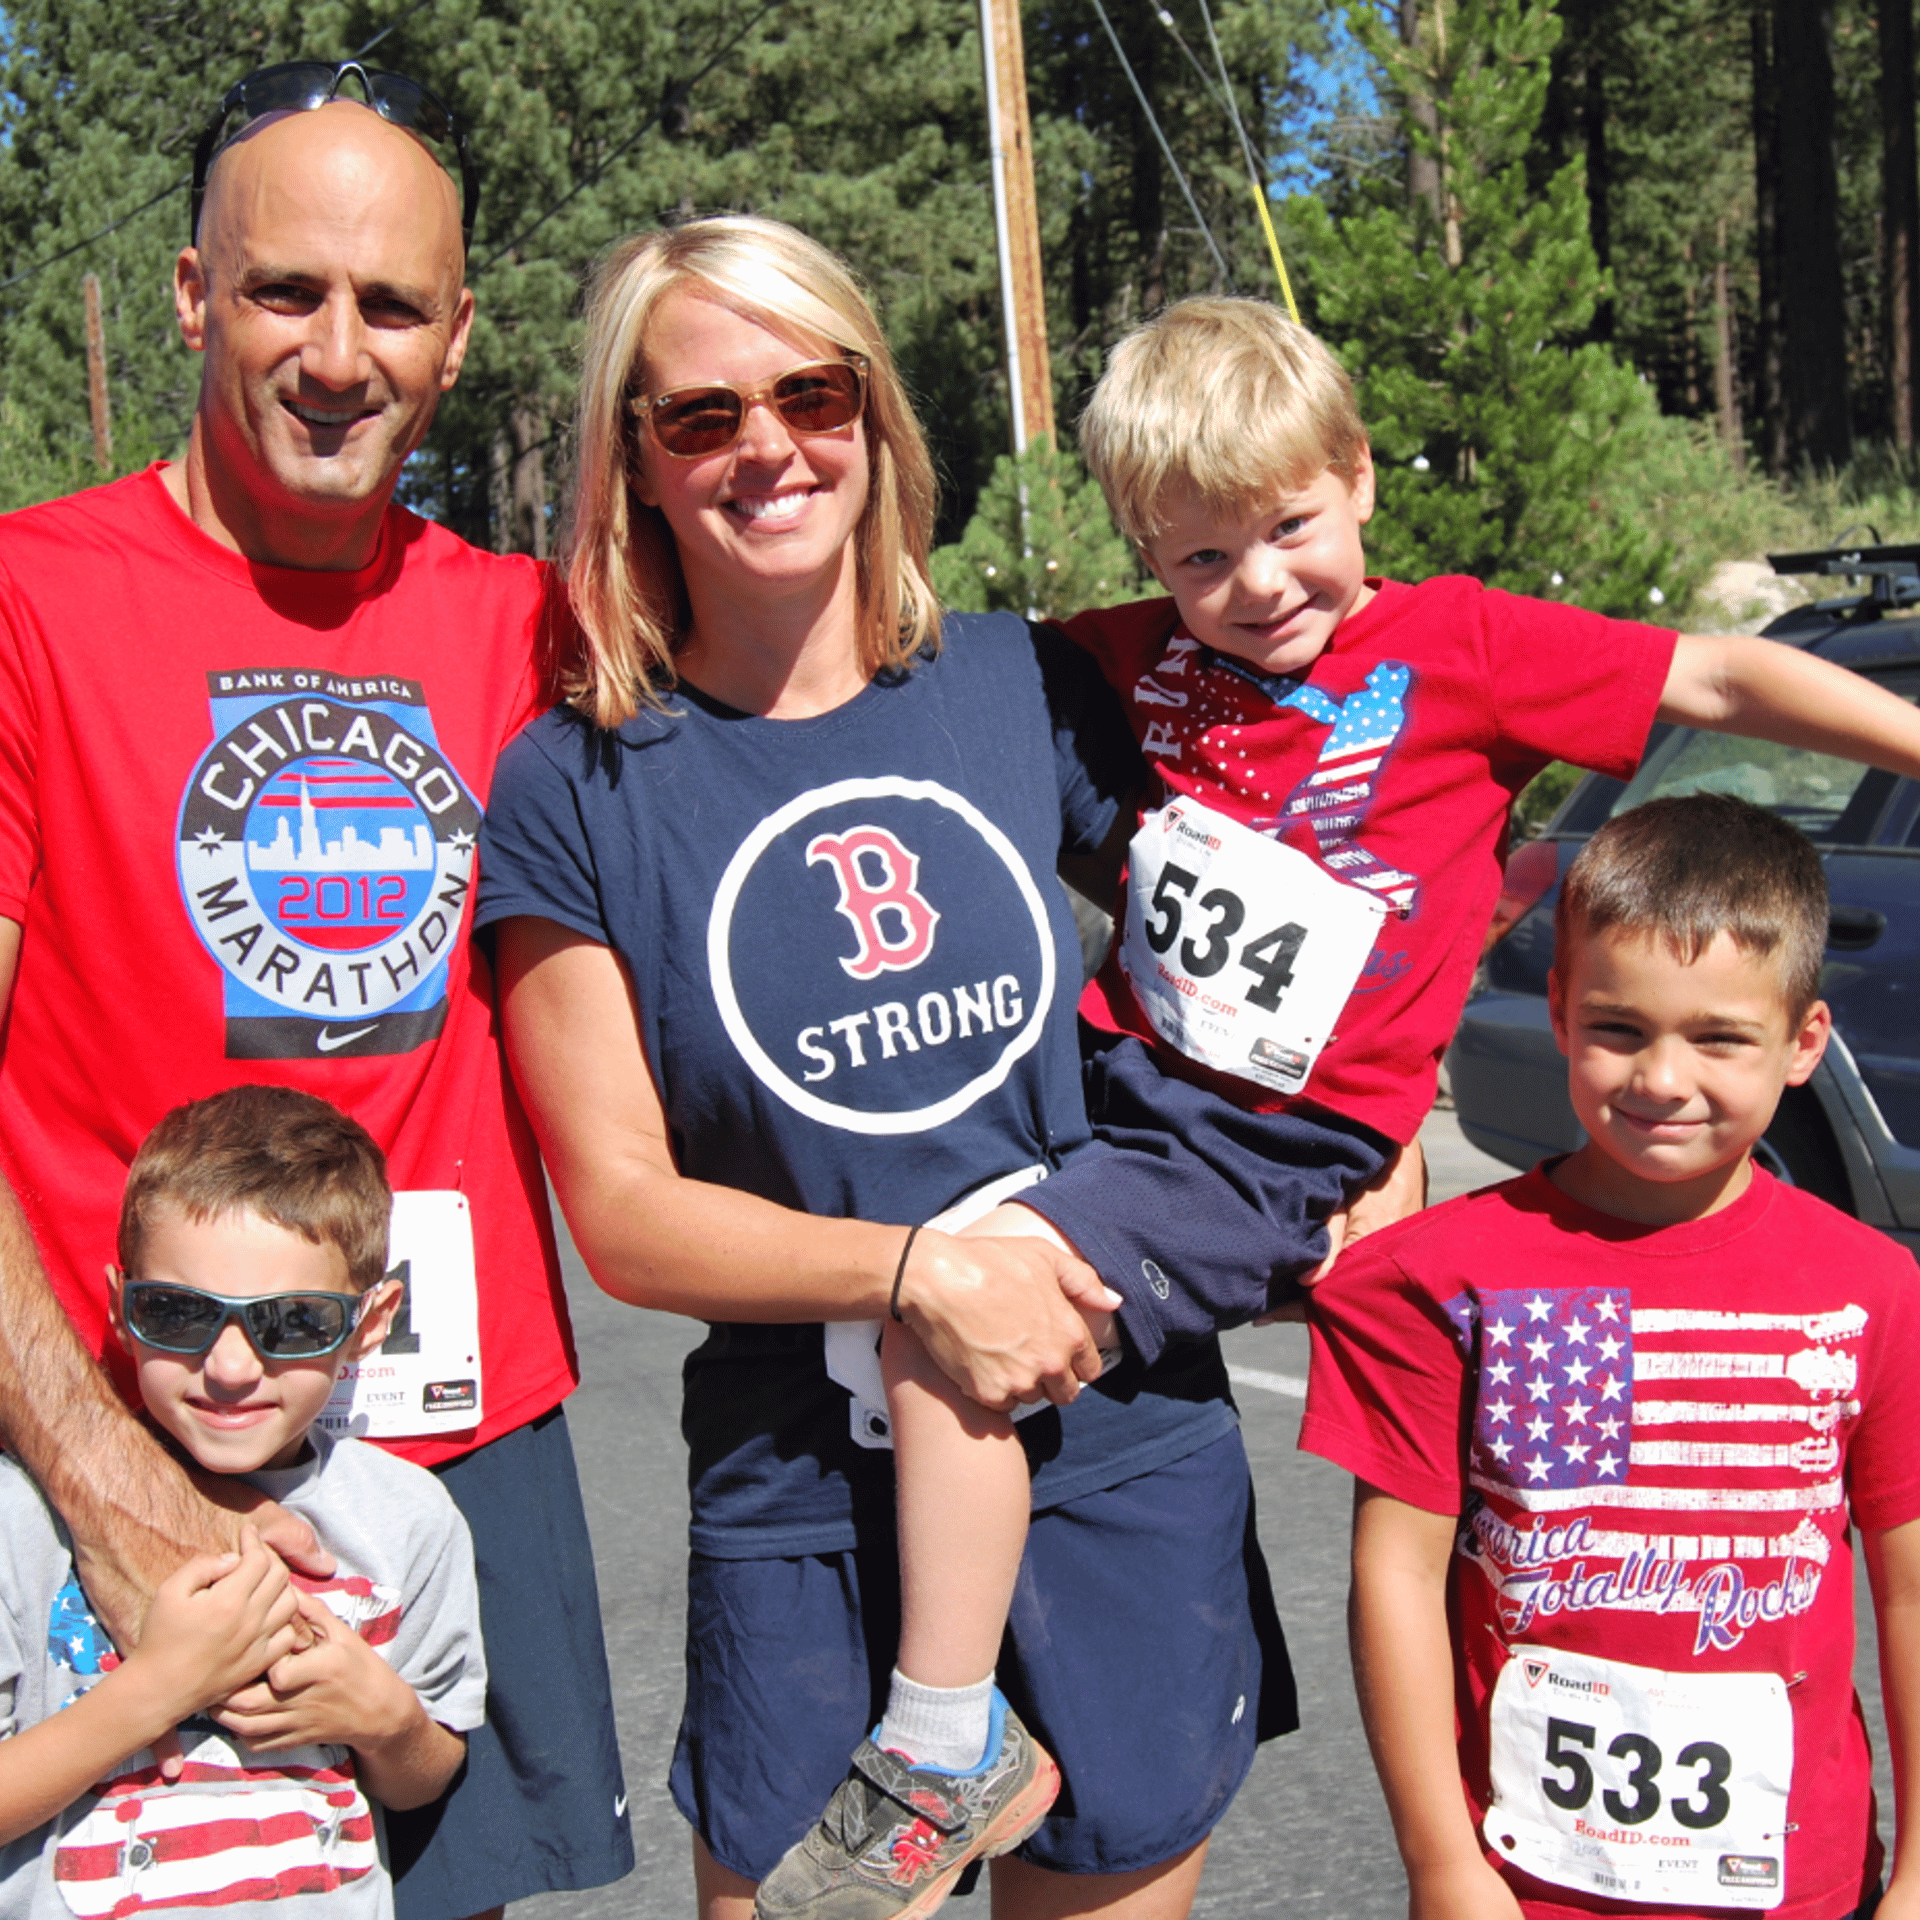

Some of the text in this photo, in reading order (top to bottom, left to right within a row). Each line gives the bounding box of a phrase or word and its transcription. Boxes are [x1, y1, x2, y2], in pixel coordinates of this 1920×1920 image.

[218, 673, 412, 698] BANK OF AMERICA
[200, 703, 459, 815] CHICAGO
[277, 875, 408, 920] 2012
[805, 824, 941, 981] B
[196, 872, 470, 1008] MARATHON
[1144, 860, 1309, 1014] 534
[1157, 961, 1239, 1018] RoadID.com
[797, 974, 1023, 1082] STRONG
[366, 1391, 406, 1403] EVENT
[1496, 1549, 1693, 1635] Totally
[1549, 1672, 1611, 1697] RoadID
[1541, 1716, 1733, 1830] 533
[1574, 1818, 1692, 1847] RoadID.com
[1658, 1859, 1699, 1869] EVENT
